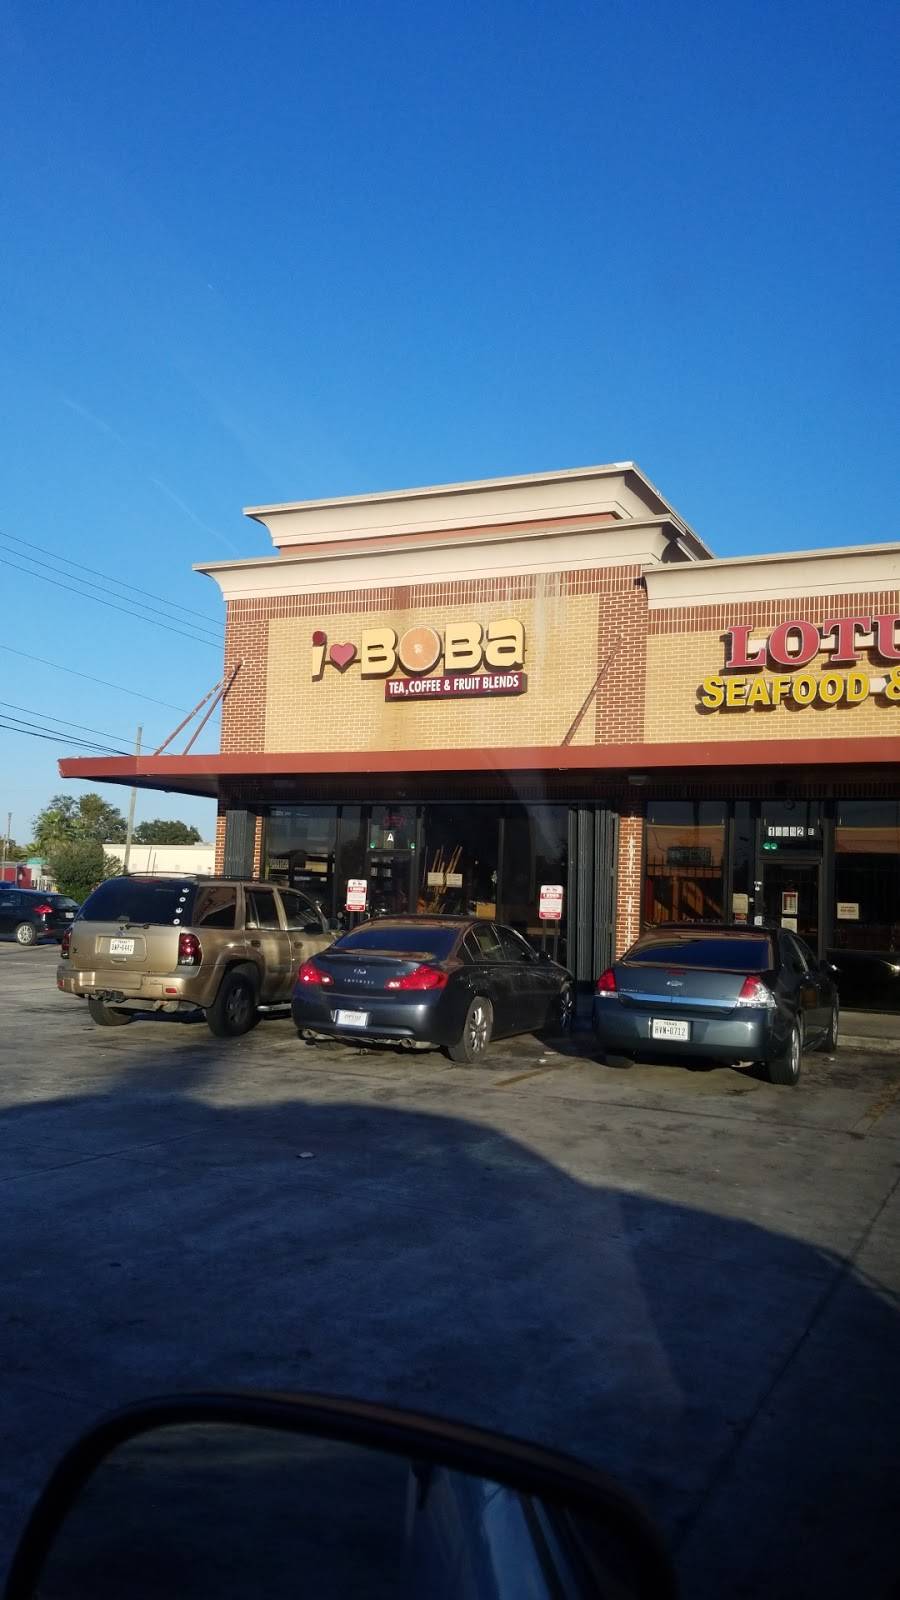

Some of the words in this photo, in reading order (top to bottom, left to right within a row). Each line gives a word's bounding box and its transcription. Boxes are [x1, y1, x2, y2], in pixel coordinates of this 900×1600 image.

[443, 679, 451, 691] &
[453, 677, 481, 691] FRUIT
[482, 675, 519, 689] BLENDS
[702, 671, 871, 708] SEAFOOD
